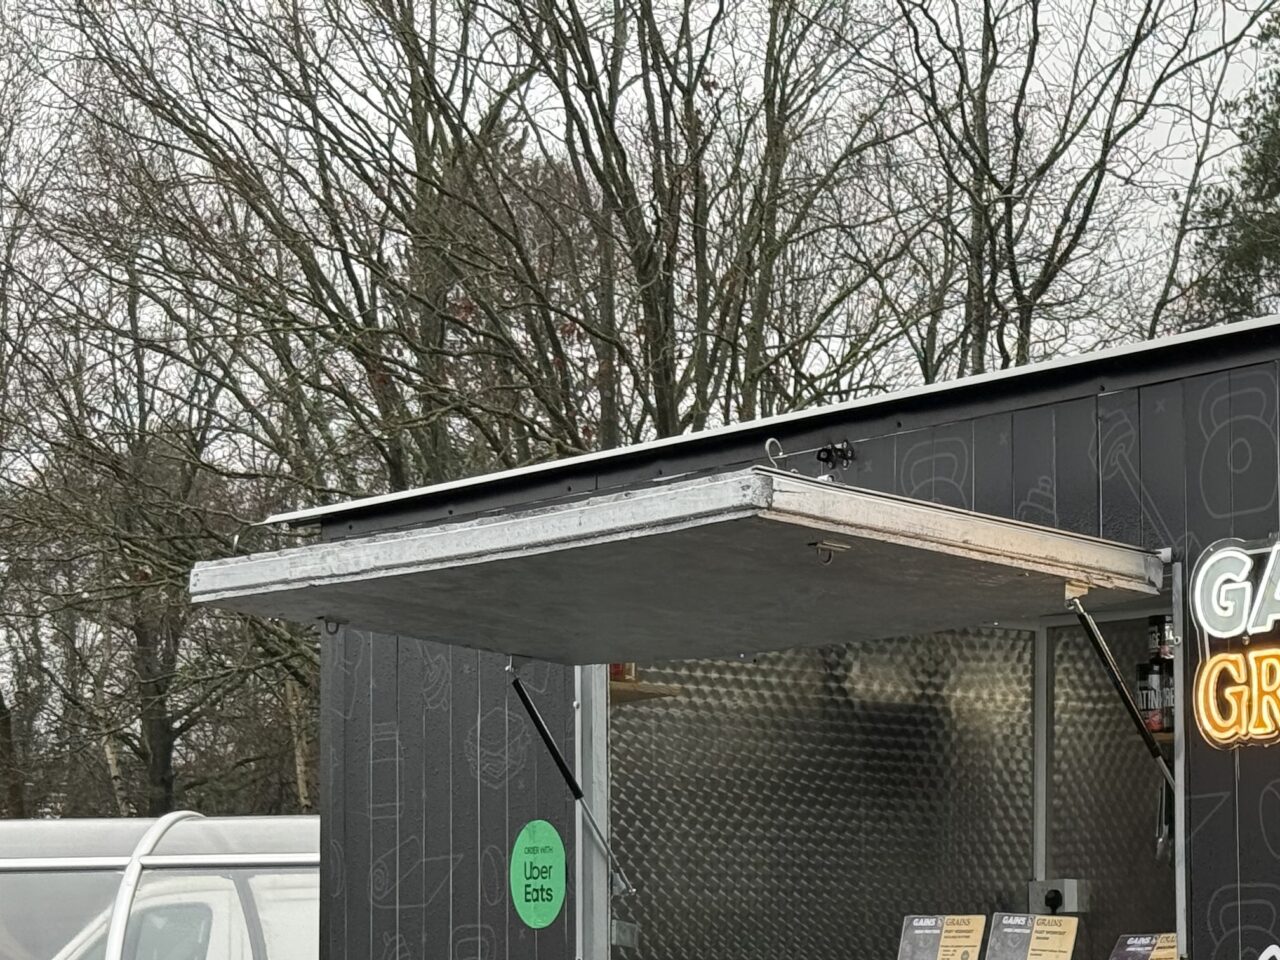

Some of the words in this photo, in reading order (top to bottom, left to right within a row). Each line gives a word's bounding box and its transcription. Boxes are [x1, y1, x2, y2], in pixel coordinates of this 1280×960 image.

[524, 861, 553, 880] Uber
[524, 884, 553, 902] Eats
[913, 918, 937, 926] GAINS
[1002, 916, 1027, 925] GAINS
[1036, 918, 1063, 927] GRAINS
